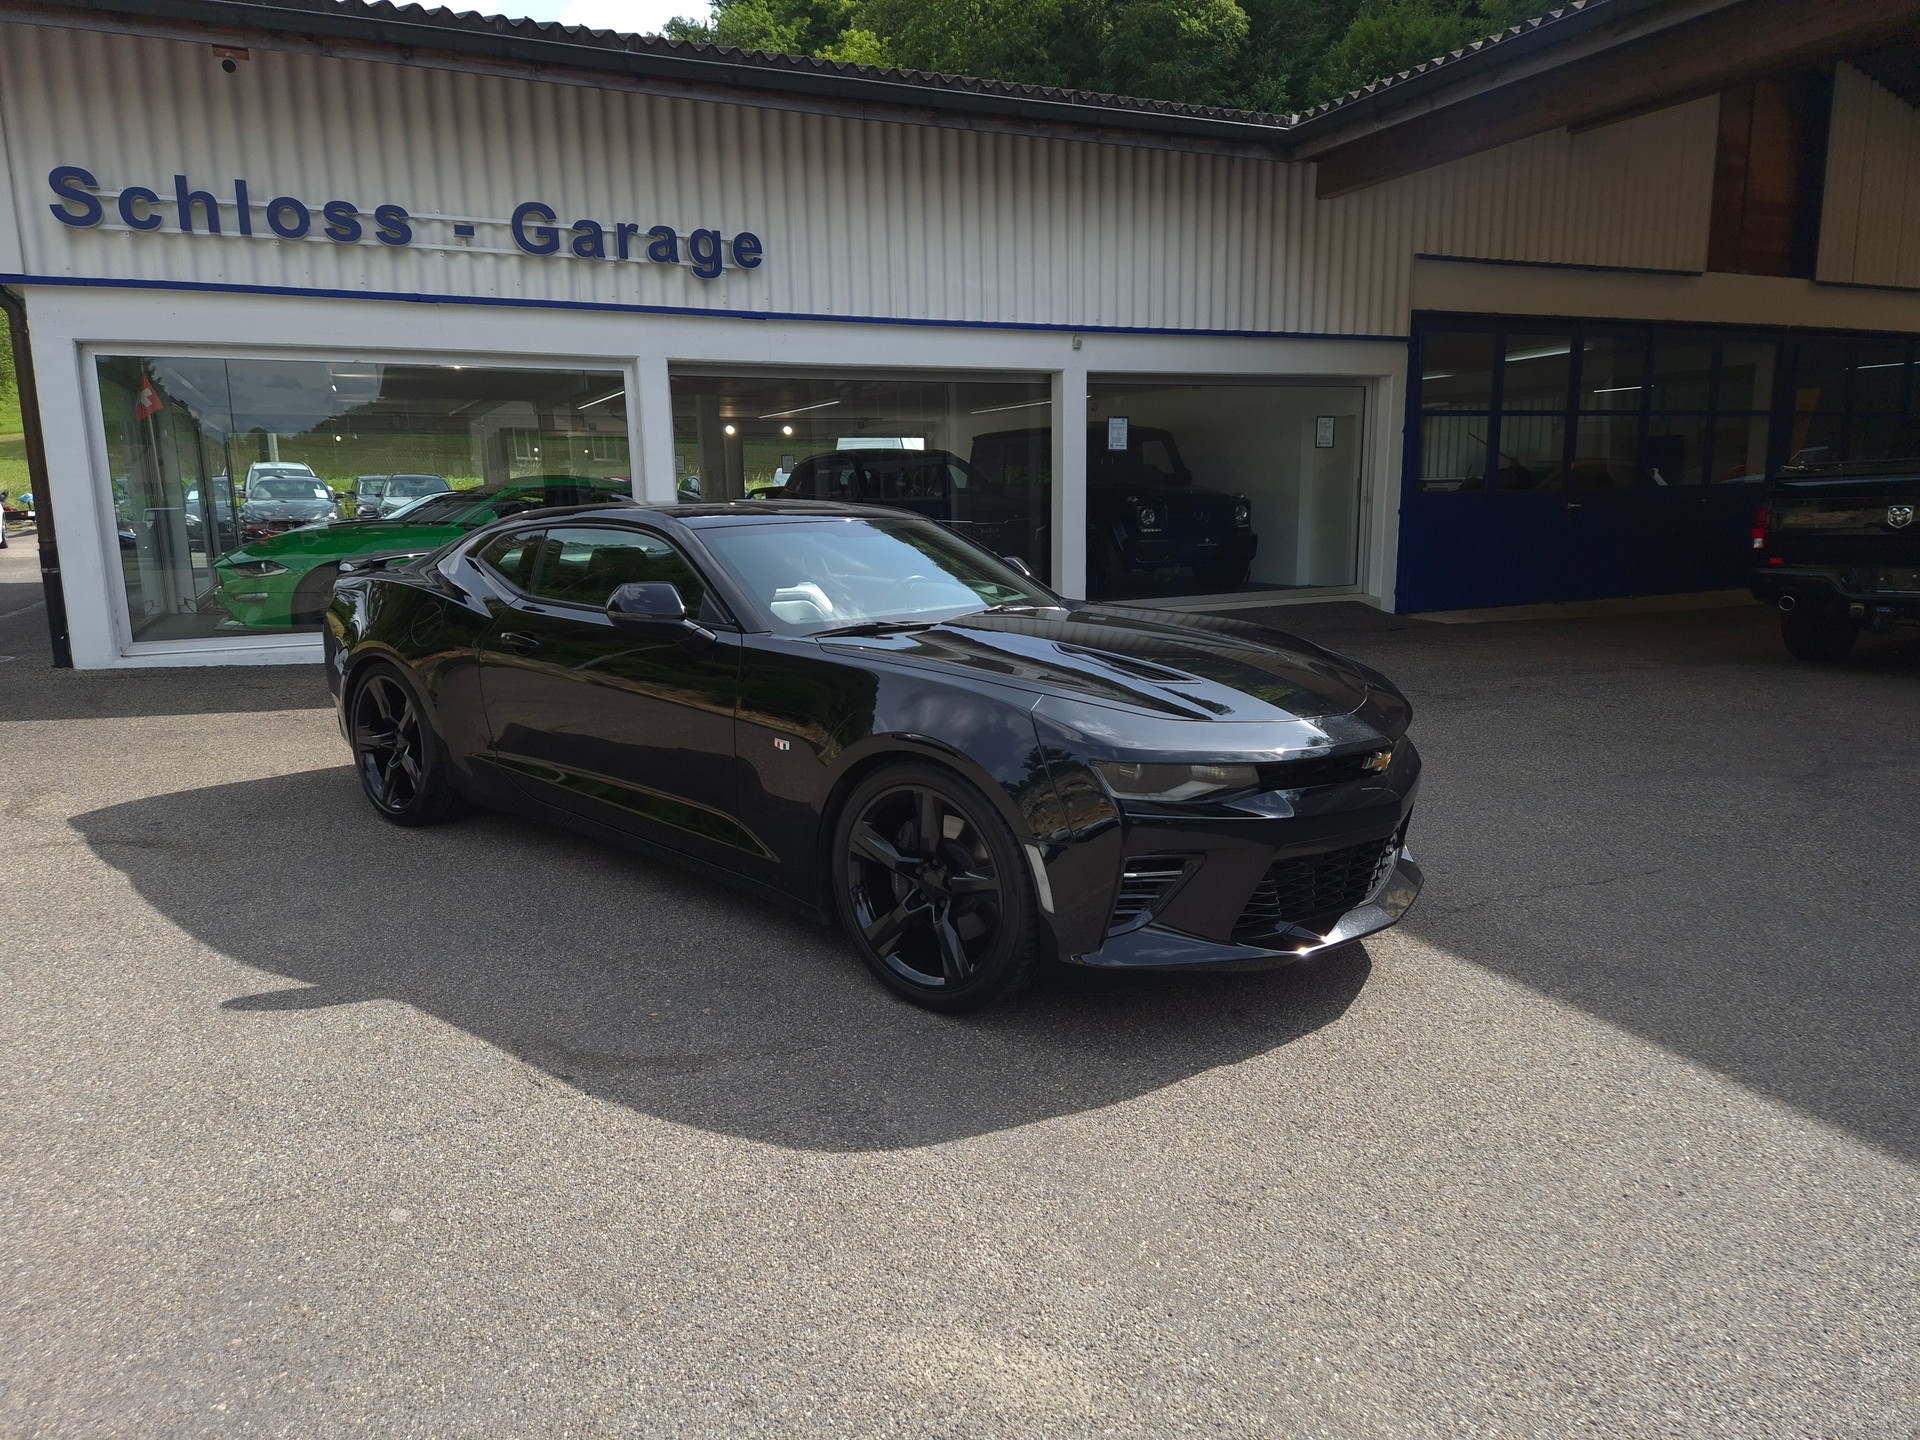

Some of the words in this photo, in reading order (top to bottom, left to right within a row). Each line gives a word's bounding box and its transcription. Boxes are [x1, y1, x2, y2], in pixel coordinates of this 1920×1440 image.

[48, 165, 413, 246] Schloss
[453, 224, 475, 238] -
[511, 201, 763, 279] Garage
